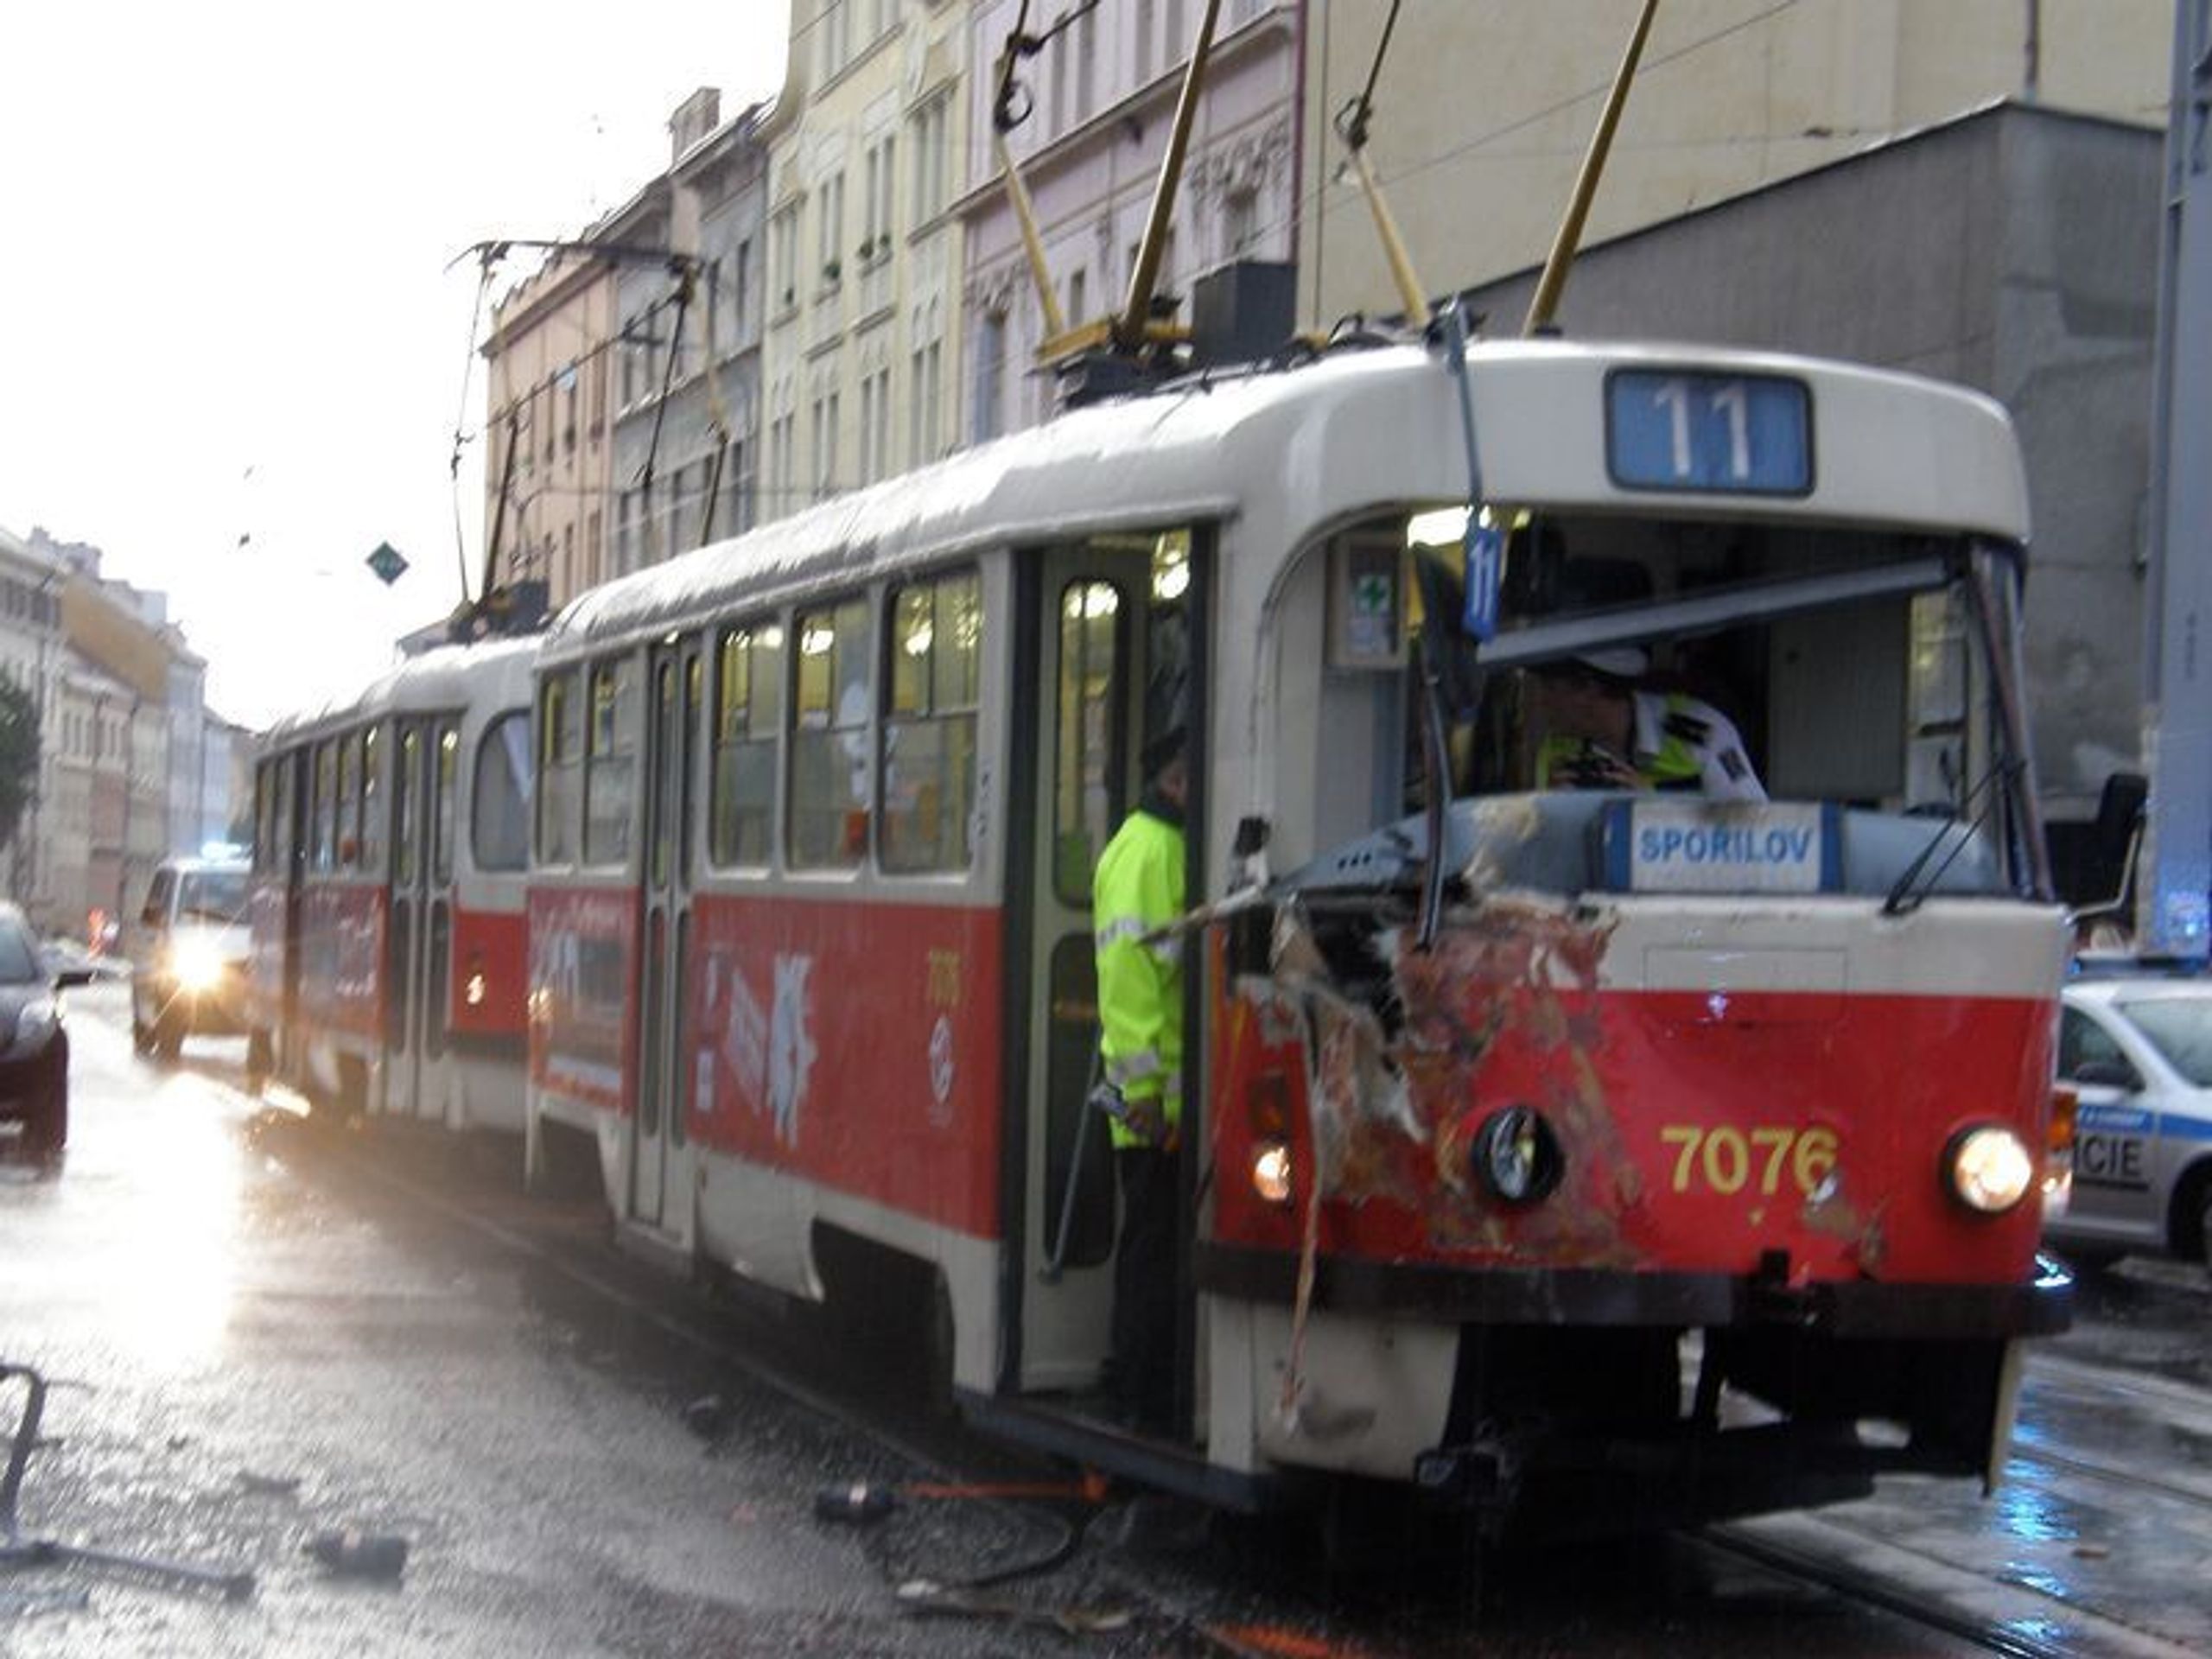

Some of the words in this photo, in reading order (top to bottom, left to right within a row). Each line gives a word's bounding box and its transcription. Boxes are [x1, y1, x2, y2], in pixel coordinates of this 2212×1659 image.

[1653, 378, 1750, 479] 11
[1470, 537, 1497, 622] 11
[1659, 1123, 1838, 1199] 7076
